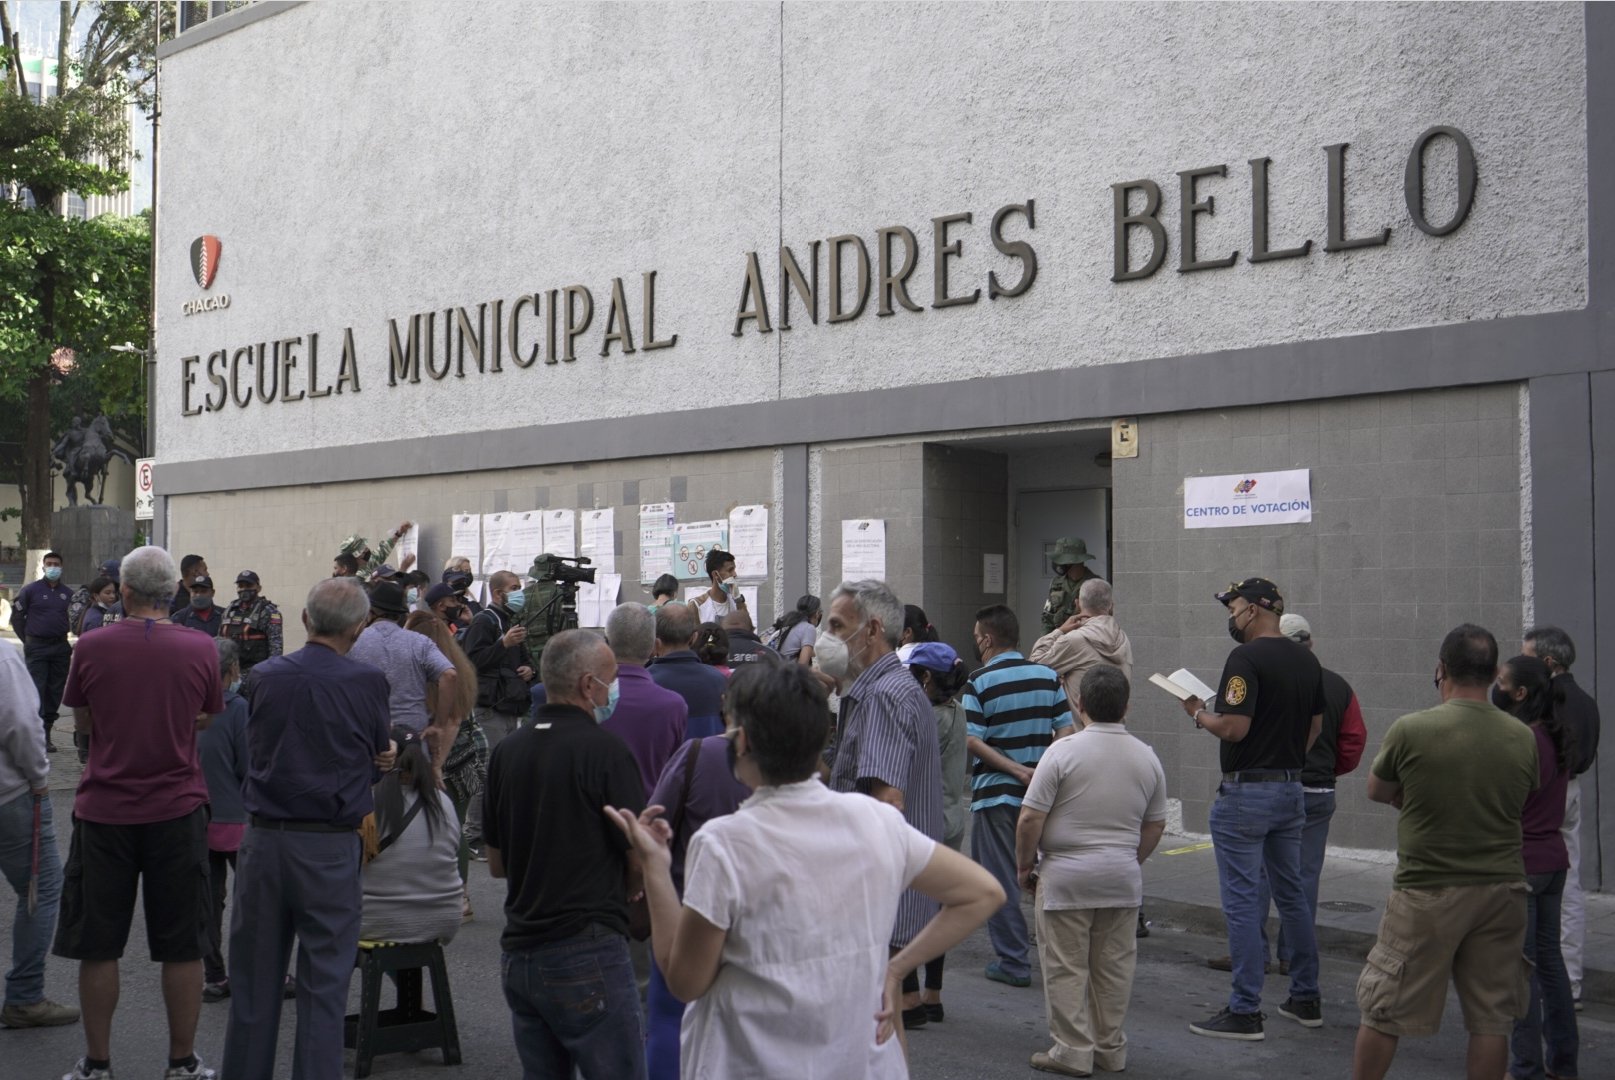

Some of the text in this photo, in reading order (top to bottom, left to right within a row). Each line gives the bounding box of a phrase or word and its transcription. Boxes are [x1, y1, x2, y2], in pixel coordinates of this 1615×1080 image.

[181, 125, 1479, 416] ESCUELA MUNICIPAL ANDRES BELLO
[182, 294, 231, 316] CHACAO
[1186, 499, 1310, 517] CENTRO DE VOTACIÓN
